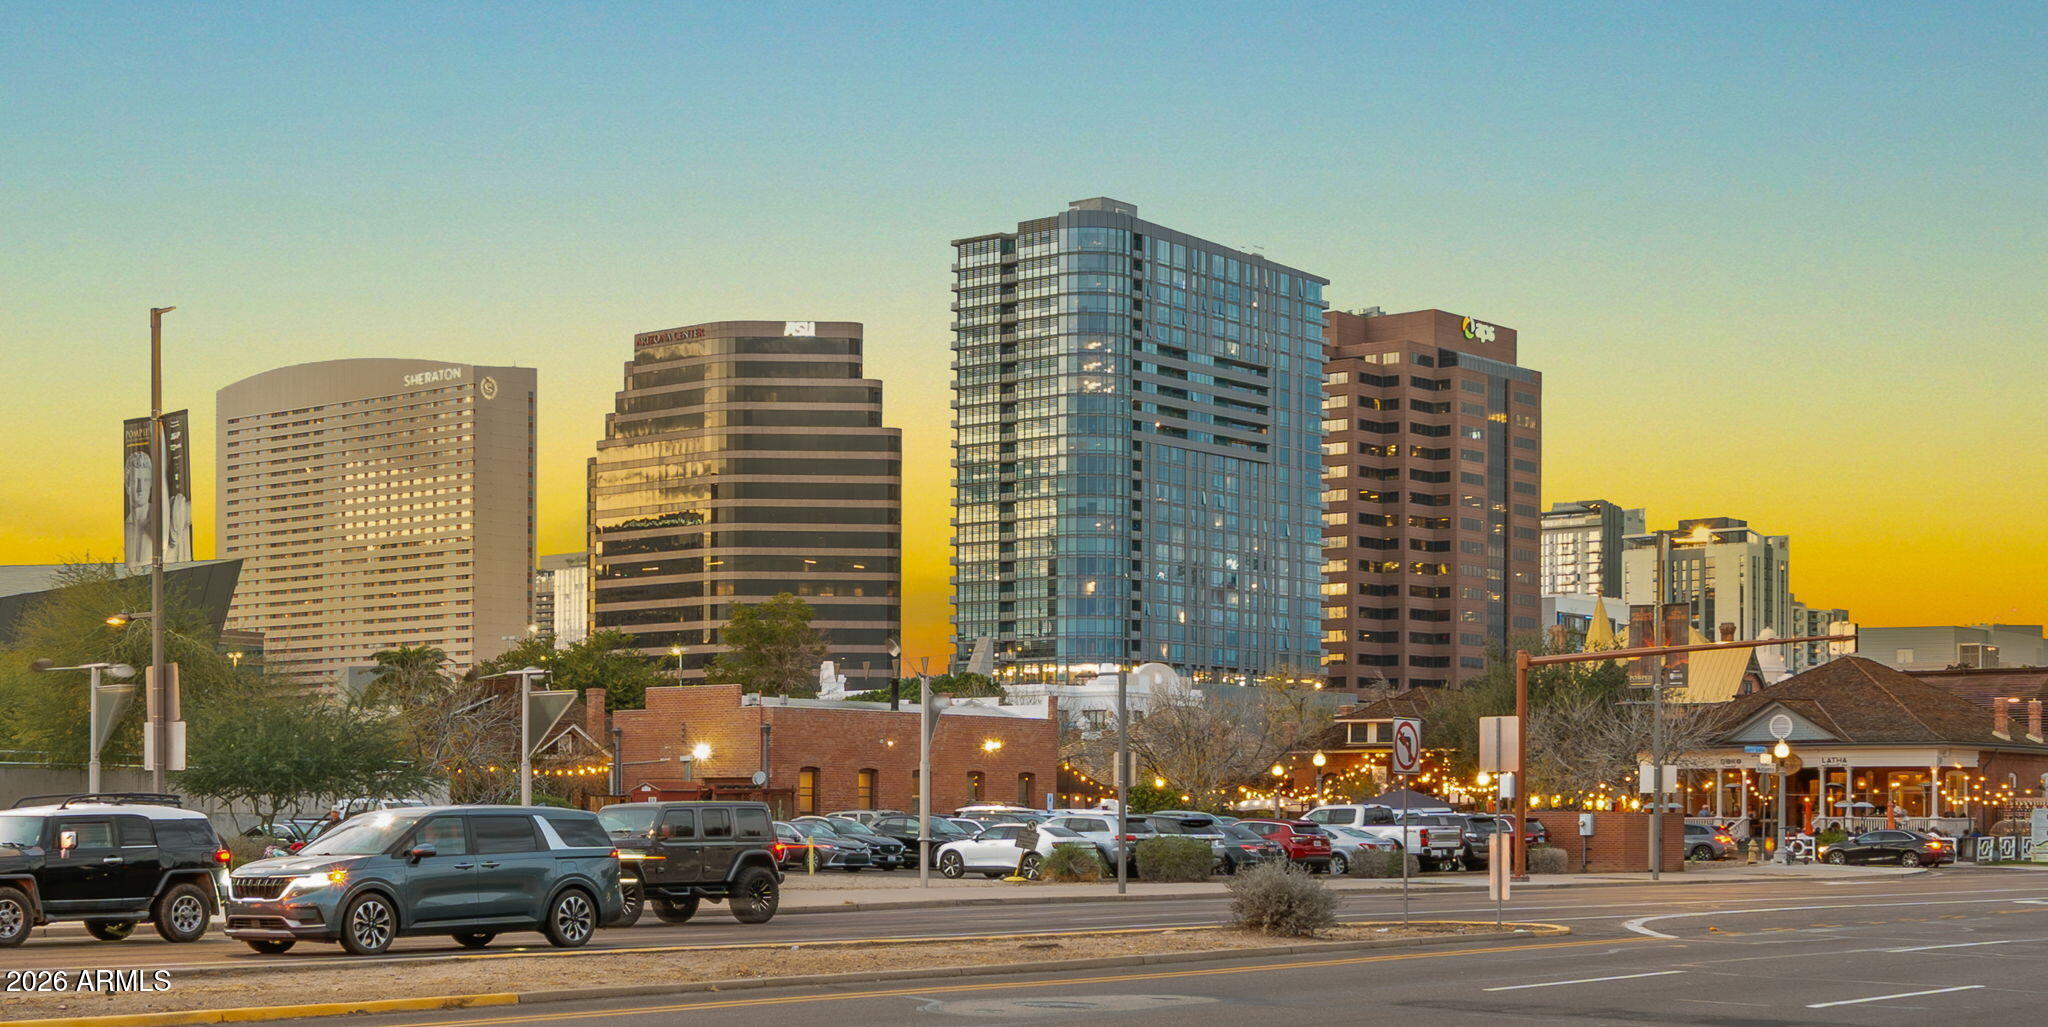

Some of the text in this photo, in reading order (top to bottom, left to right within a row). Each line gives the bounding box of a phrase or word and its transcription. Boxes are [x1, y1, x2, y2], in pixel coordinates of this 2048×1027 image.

[674, 327, 705, 341] CENTER
[1475, 322, 1496, 343] aps
[404, 368, 462, 387] SHERATON
[1821, 756, 1848, 764] LATHA
